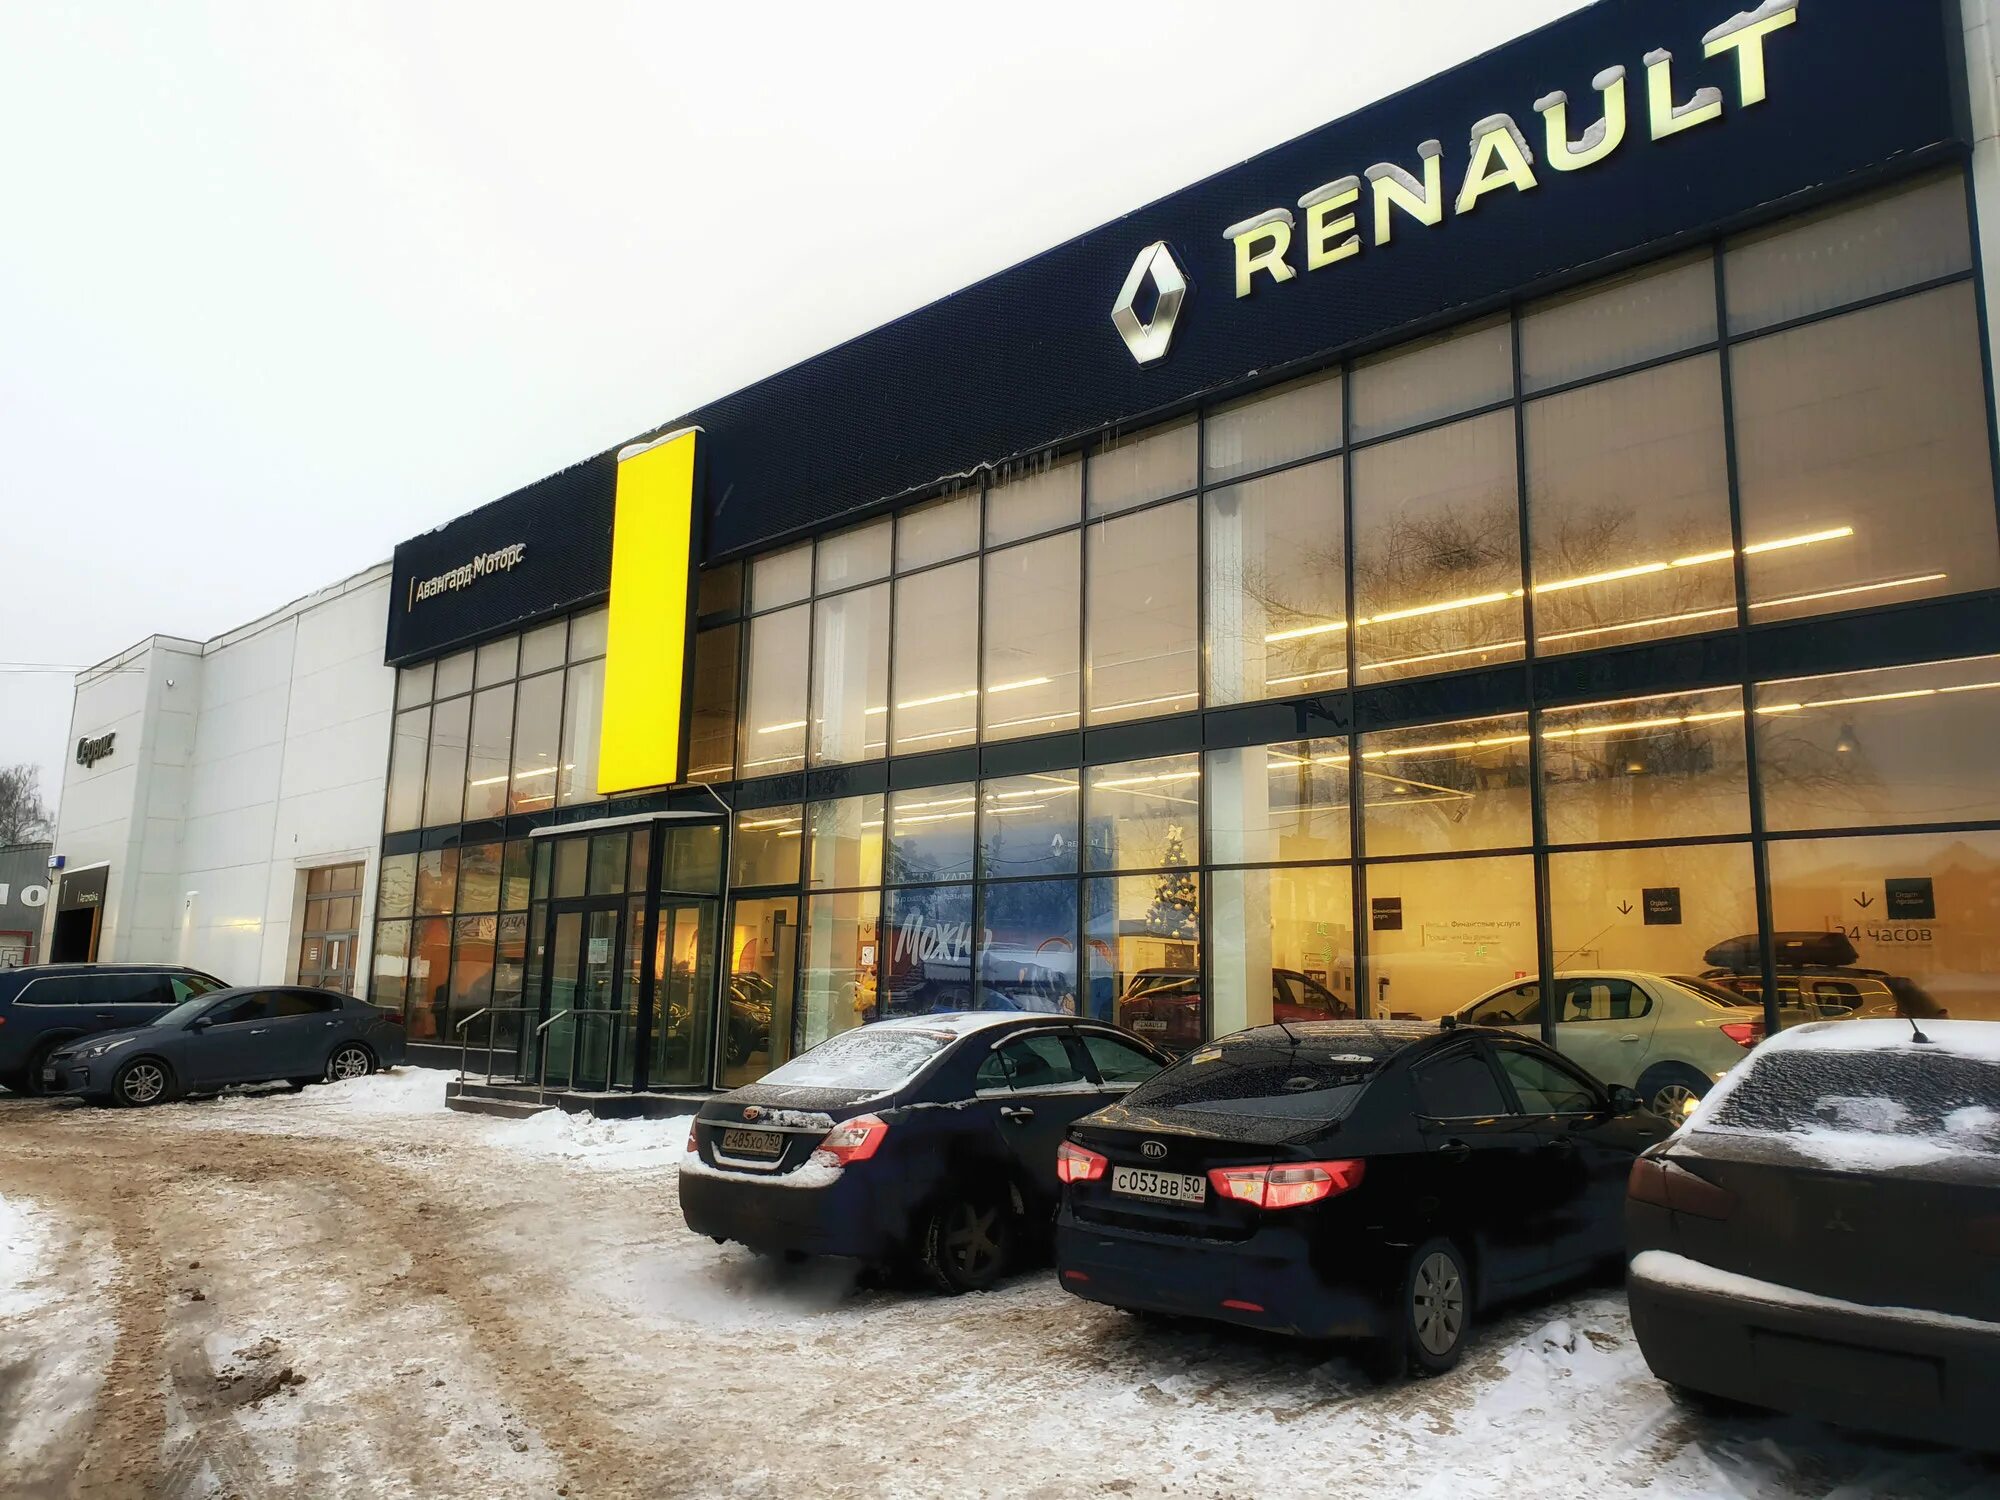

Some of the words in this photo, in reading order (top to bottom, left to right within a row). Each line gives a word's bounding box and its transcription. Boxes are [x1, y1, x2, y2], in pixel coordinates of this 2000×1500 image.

[1234, 6, 1798, 298] RENAULT
[76, 732, 116, 768] Сервис
[1067, 839, 1100, 848] RELT
[1497, 919, 1521, 928] услуги
[1867, 929, 1932, 941] часов
[765, 1134, 780, 1147] 750
[1143, 1145, 1161, 1156] KIA
[1118, 1171, 1179, 1196] C053BB
[1184, 1176, 1200, 1193] 50
